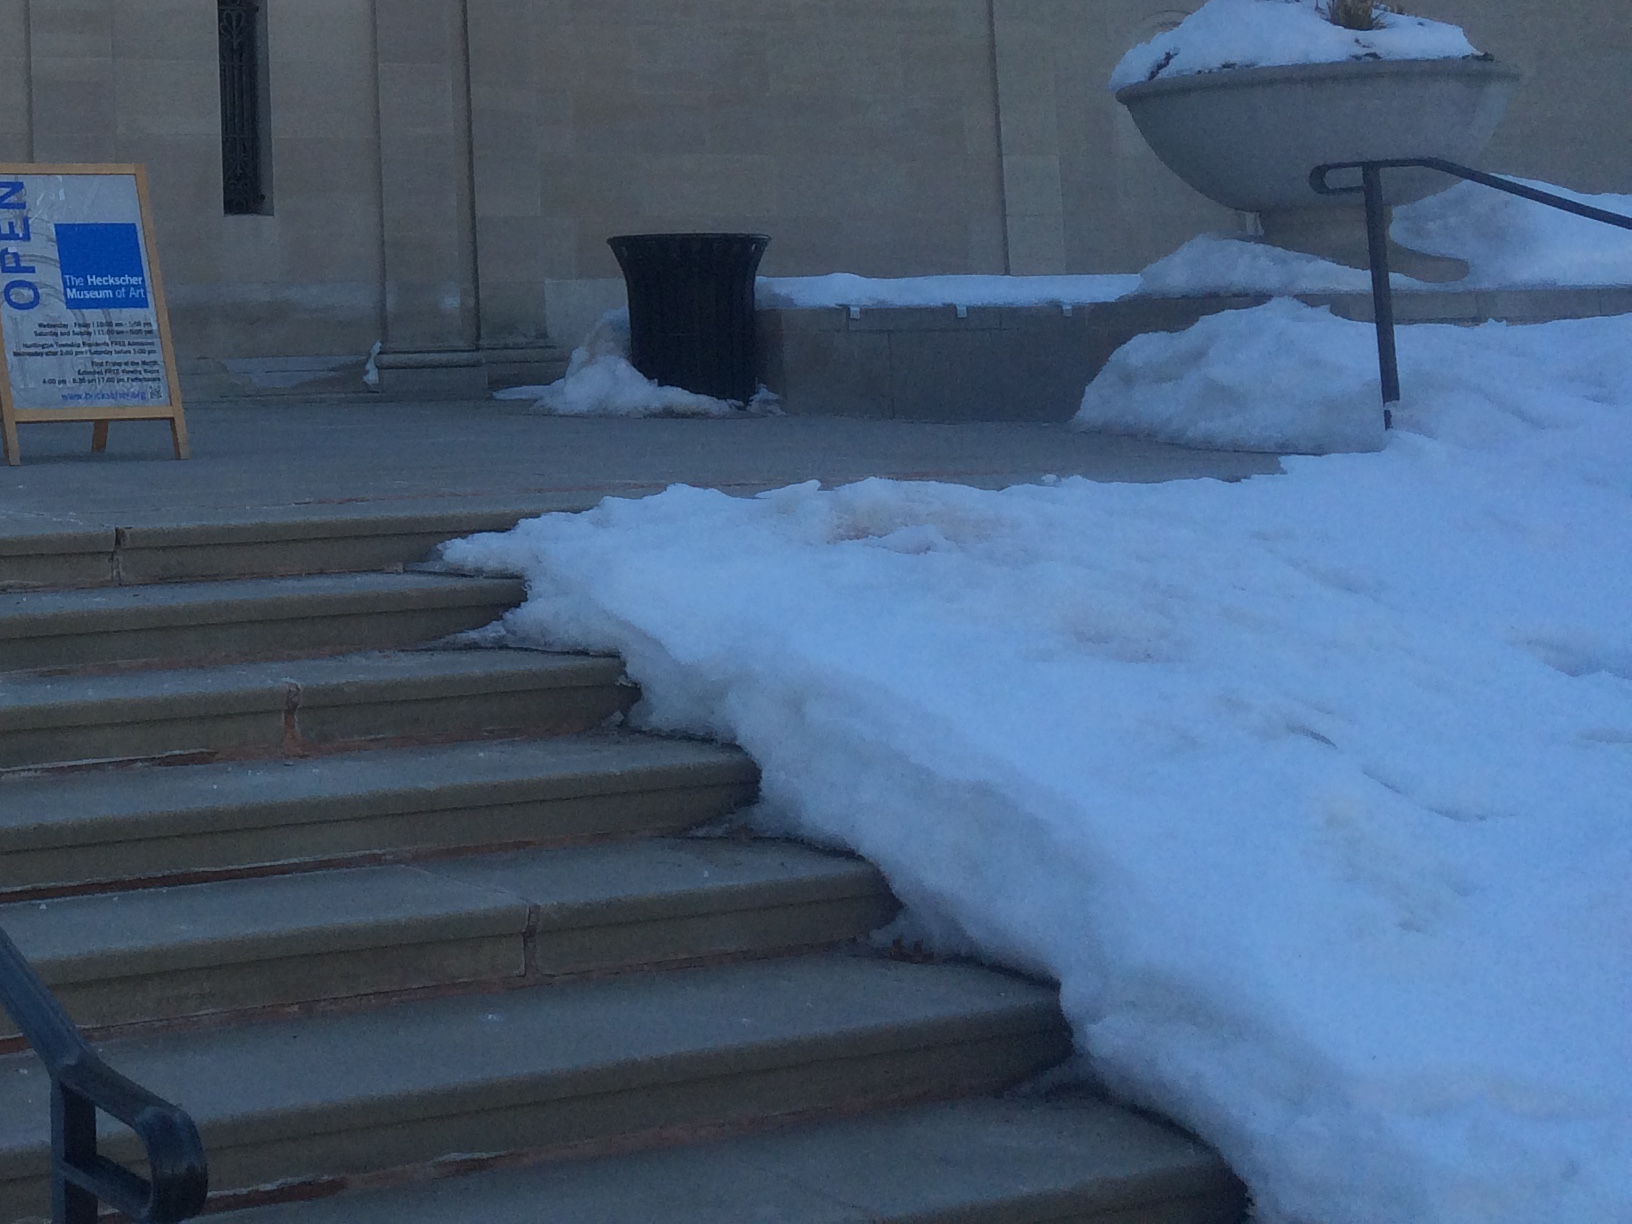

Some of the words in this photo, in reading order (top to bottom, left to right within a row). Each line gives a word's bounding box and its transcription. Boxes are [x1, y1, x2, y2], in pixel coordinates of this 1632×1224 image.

[64, 274, 84, 286] The
[87, 274, 143, 286] Heckscher
[66, 287, 113, 299] Museum
[115, 287, 126, 298] of
[129, 287, 145, 298] Art
